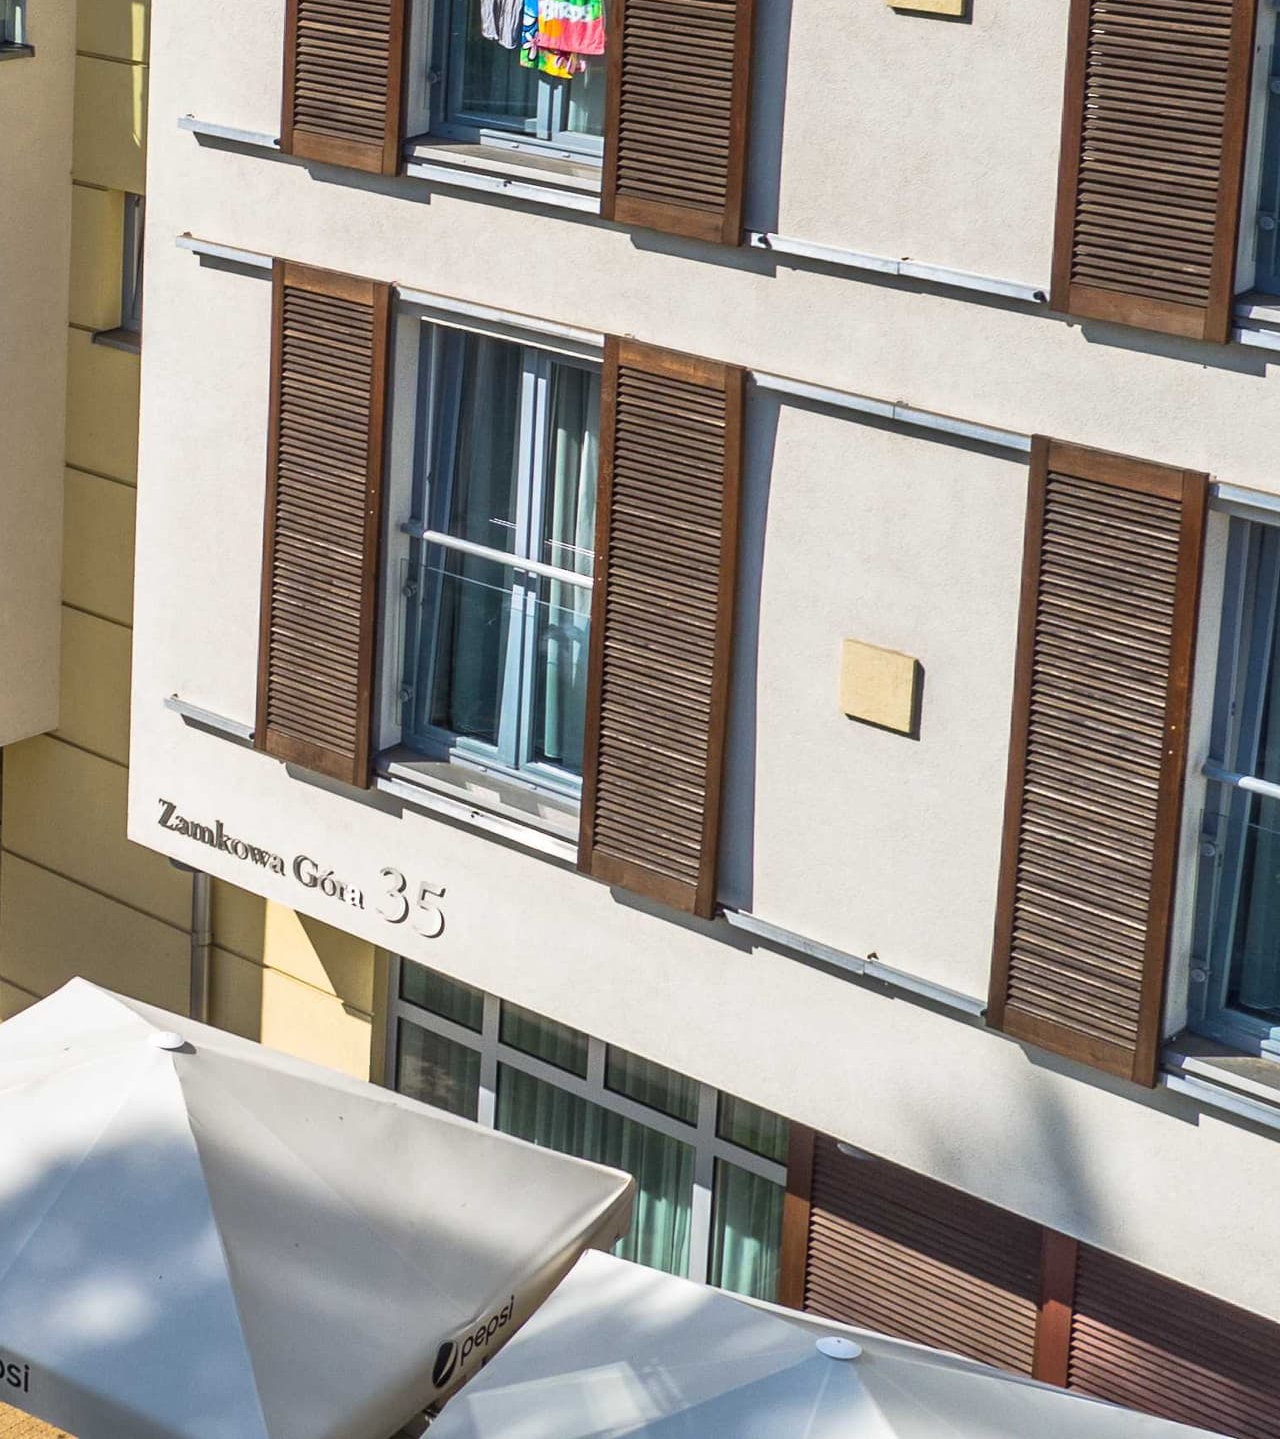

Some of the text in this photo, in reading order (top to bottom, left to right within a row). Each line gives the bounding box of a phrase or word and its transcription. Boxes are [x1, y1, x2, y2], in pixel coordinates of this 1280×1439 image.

[158, 797, 447, 940] Zamkowa Góra 35
[460, 1293, 515, 1367] pepsi
